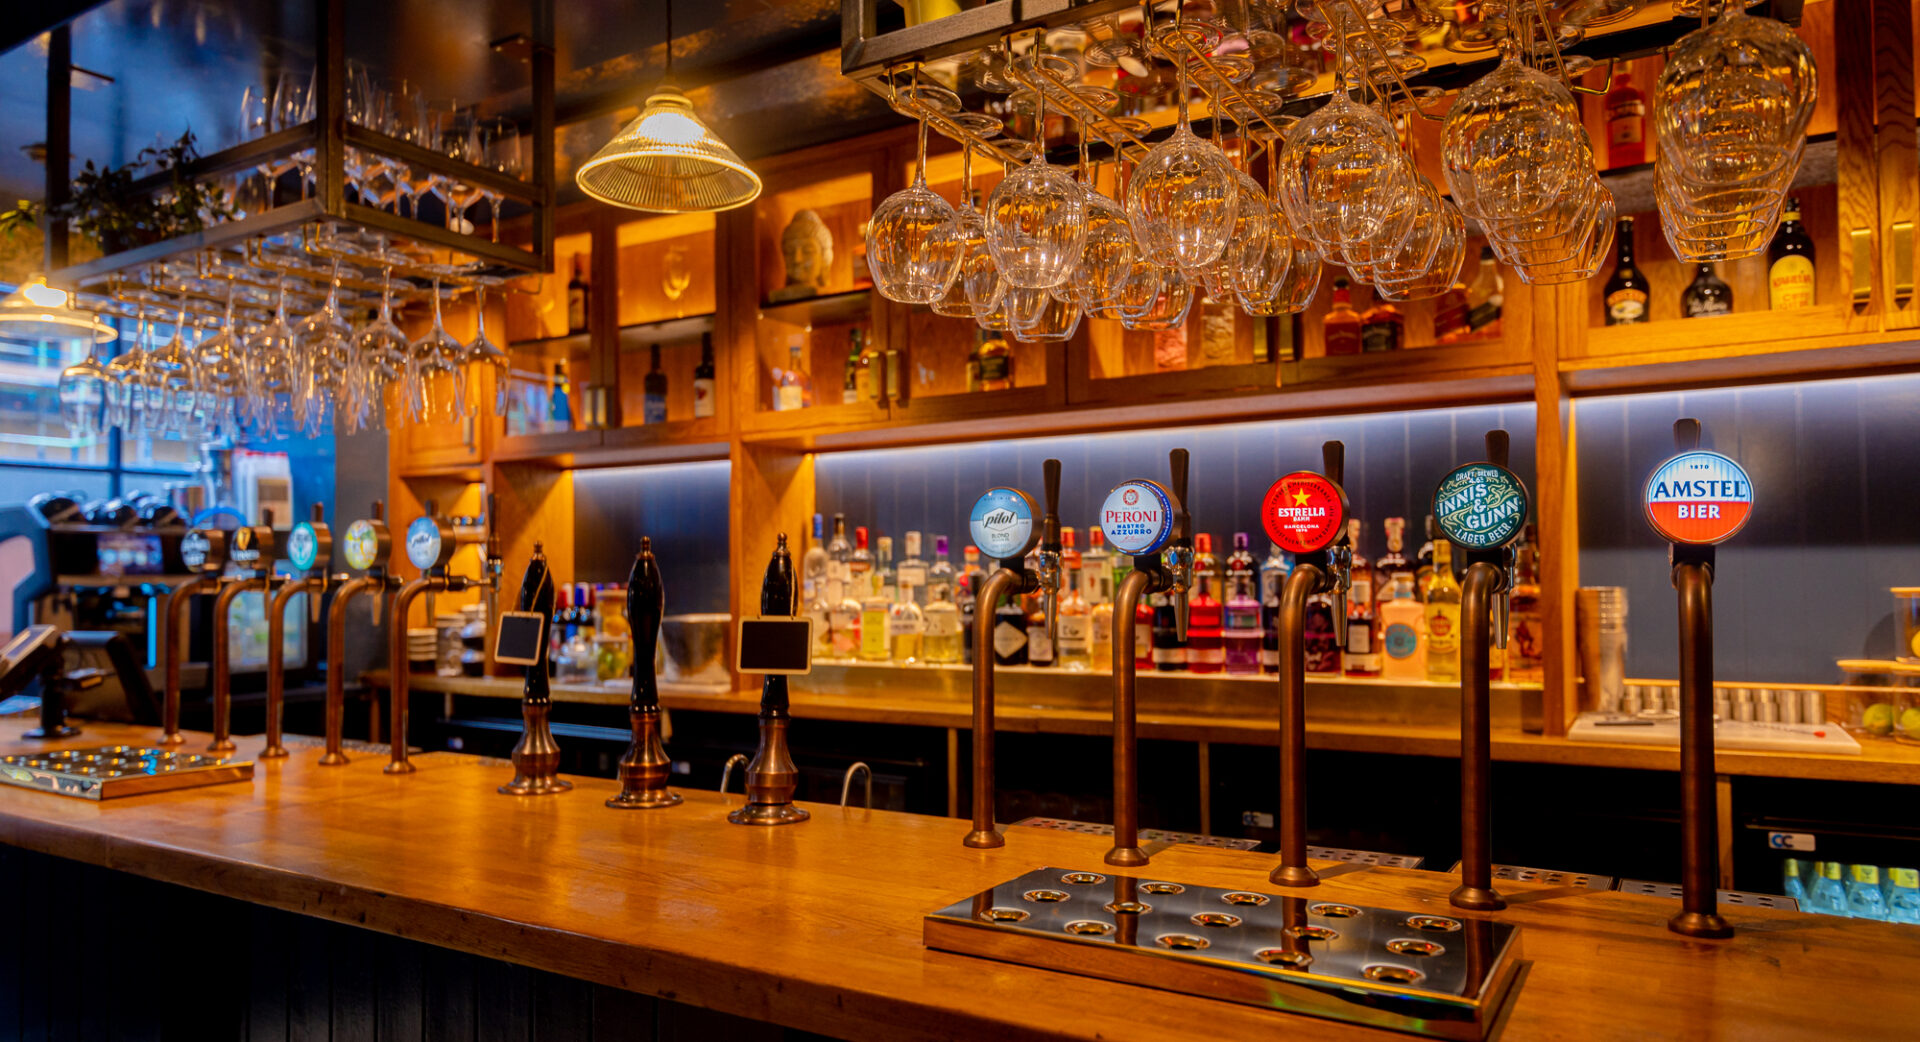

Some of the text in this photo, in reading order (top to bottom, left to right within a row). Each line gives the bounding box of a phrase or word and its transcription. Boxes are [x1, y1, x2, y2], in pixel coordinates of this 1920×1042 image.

[1456, 469, 1499, 482] CRAFT BREWED
[1653, 480, 1746, 498] AMSTEL
[1440, 483, 1488, 517] INNIS
[1473, 498, 1487, 513] &
[984, 511, 1016, 528] pilot
[1105, 510, 1157, 523] PERONI
[1278, 507, 1326, 517] ESTRELLA
[1466, 496, 1520, 529] GUNN
[1678, 504, 1720, 519] BIER
[1456, 522, 1511, 544] LAGER BEER
[1771, 833, 1794, 849] CC
